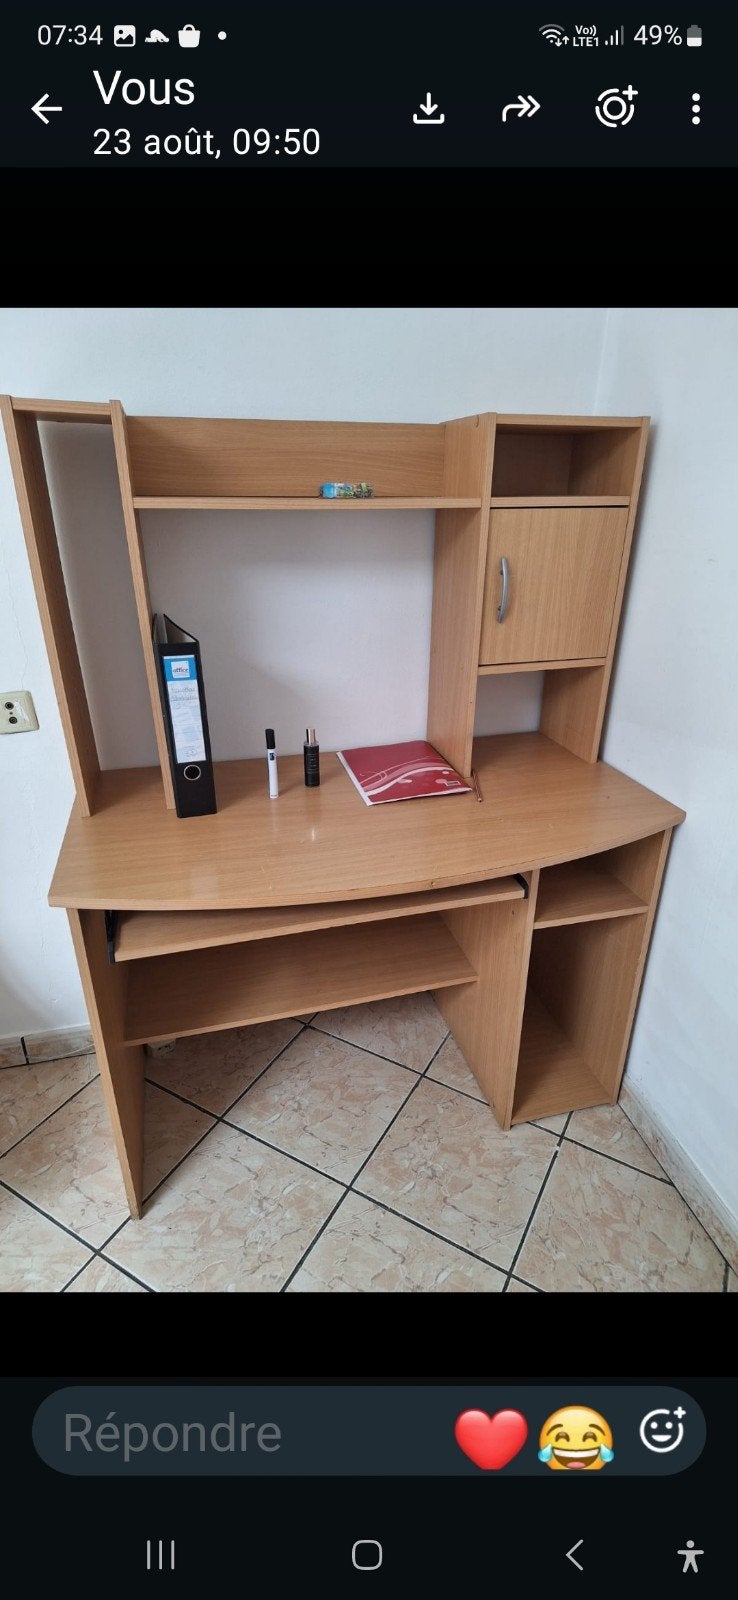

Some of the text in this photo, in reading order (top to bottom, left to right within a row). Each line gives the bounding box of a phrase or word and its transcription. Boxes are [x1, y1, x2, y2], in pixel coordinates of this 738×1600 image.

[38, 25, 103, 45] 07:34
[573, 37, 598, 46] LTE1
[634, 25, 682, 45] 49%
[93, 70, 194, 105] Vous
[94, 127, 319, 159] 23 août, 09:50
[66, 1412, 281, 1462] Répondre
